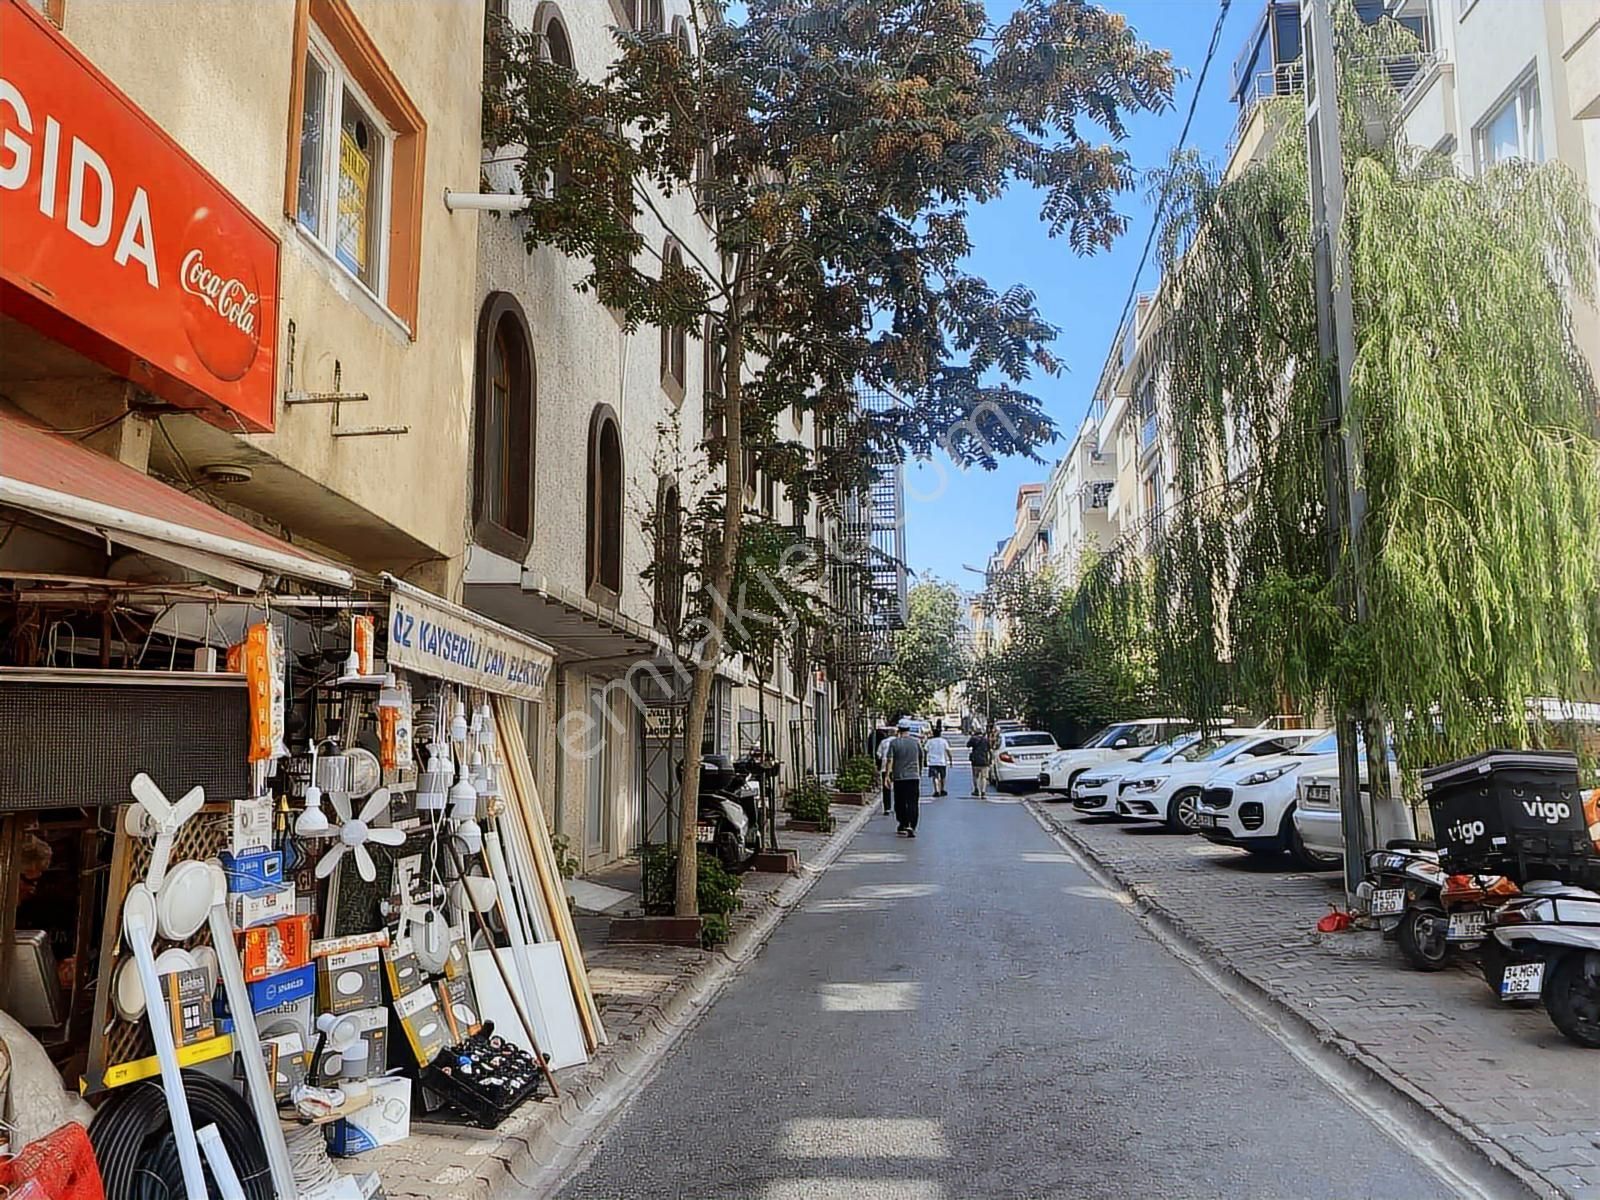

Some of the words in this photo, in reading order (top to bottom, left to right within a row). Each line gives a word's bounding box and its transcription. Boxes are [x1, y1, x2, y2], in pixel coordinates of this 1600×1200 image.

[0, 77, 160, 290] GIDA
[393, 603, 414, 648] ÖZ
[419, 620, 483, 670] KAYSERİLİ
[484, 647, 507, 677] CAN
[1522, 796, 1571, 824] vigo
[1448, 819, 1485, 844] vigo
[1505, 967, 1517, 979] 34
